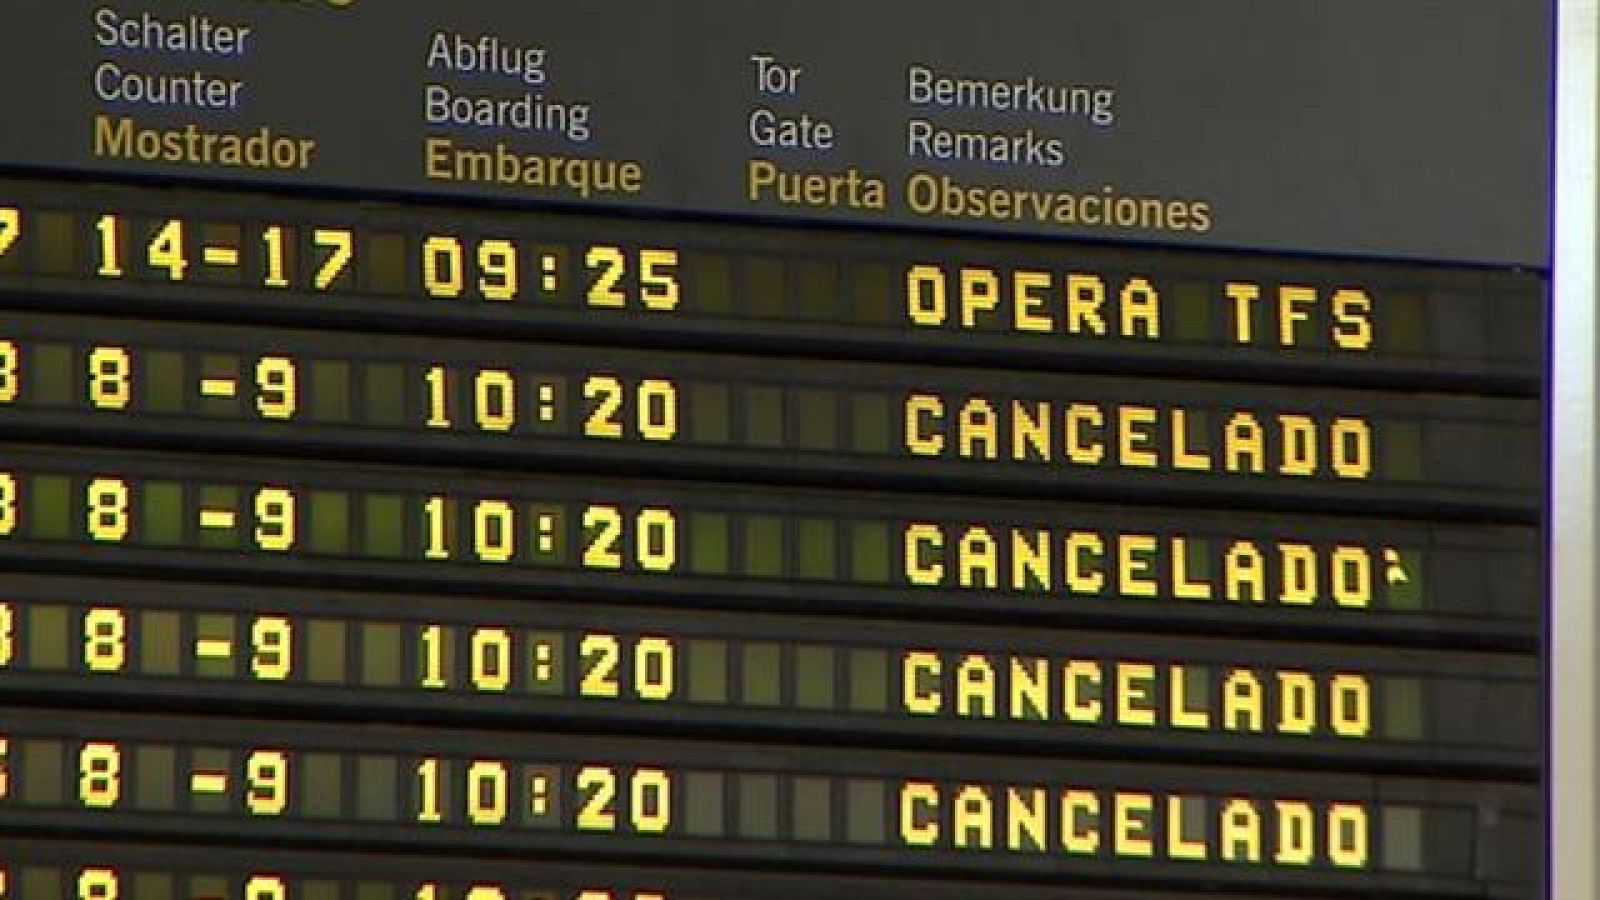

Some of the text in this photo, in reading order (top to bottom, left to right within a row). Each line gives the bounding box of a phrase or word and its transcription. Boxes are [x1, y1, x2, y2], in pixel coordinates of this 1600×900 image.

[94, 9, 250, 55] Schalter
[426, 33, 547, 84] Abflug
[94, 63, 243, 108] Counter
[751, 56, 802, 95] Tor
[908, 67, 1114, 125] Bemerkung
[93, 115, 316, 170] Mostrador
[425, 86, 591, 140] Boarding
[748, 109, 834, 150] Gate
[908, 121, 1065, 167] Remarks
[425, 139, 642, 196] Embarque
[748, 160, 886, 210] Puerta
[907, 174, 1212, 233] Observaciones
[96, 215, 353, 289] 14-17
[423, 236, 679, 310] 09:25
[908, 265, 1372, 350] OPERA TFS
[89, 347, 130, 409] 8
[425, 367, 677, 441] 10:20
[906, 395, 1370, 479] CANCELADO
[88, 479, 128, 541] 8
[424, 497, 677, 571] 10:20
[905, 523, 1371, 607] CANCELADO
[84, 608, 125, 671] 8
[421, 625, 674, 700] 10:20
[903, 651, 1370, 737] CANCELADO
[79, 743, 121, 807] 8
[418, 758, 670, 832] 10:20
[900, 781, 1367, 867] CANCELADO
